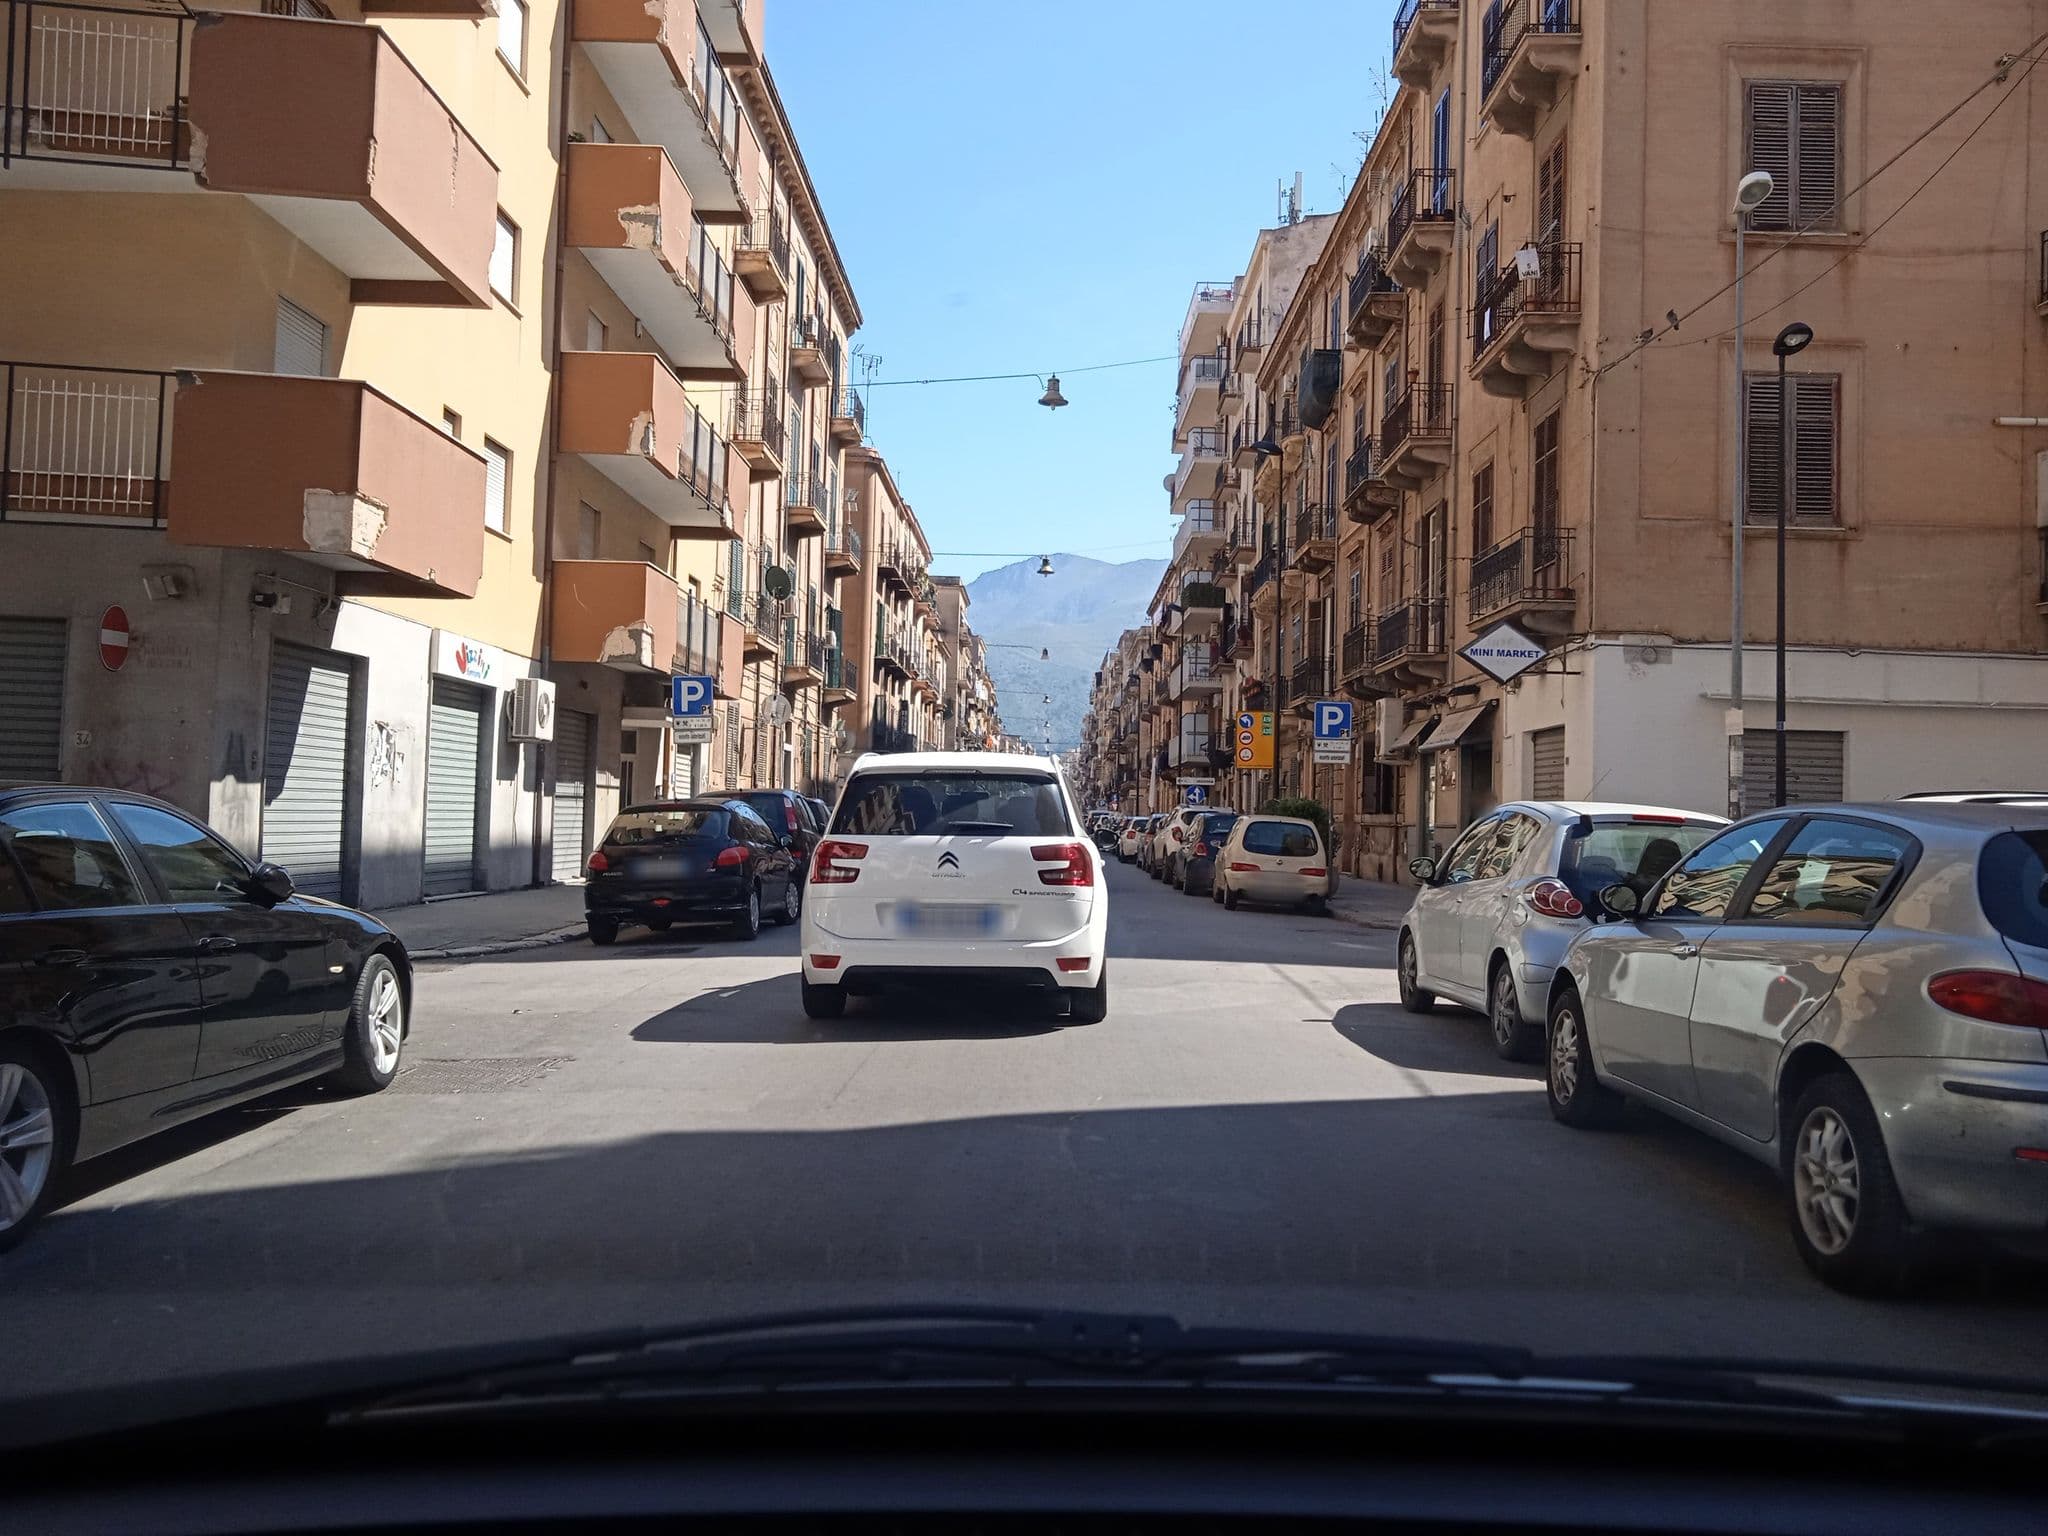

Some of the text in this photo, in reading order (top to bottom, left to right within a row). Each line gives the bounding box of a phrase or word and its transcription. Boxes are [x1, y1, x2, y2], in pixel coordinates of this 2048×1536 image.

[1469, 647, 1541, 659] MINI MARKET
[680, 680, 705, 713] P
[1321, 705, 1344, 736] P
[1011, 888, 1028, 896] C4
